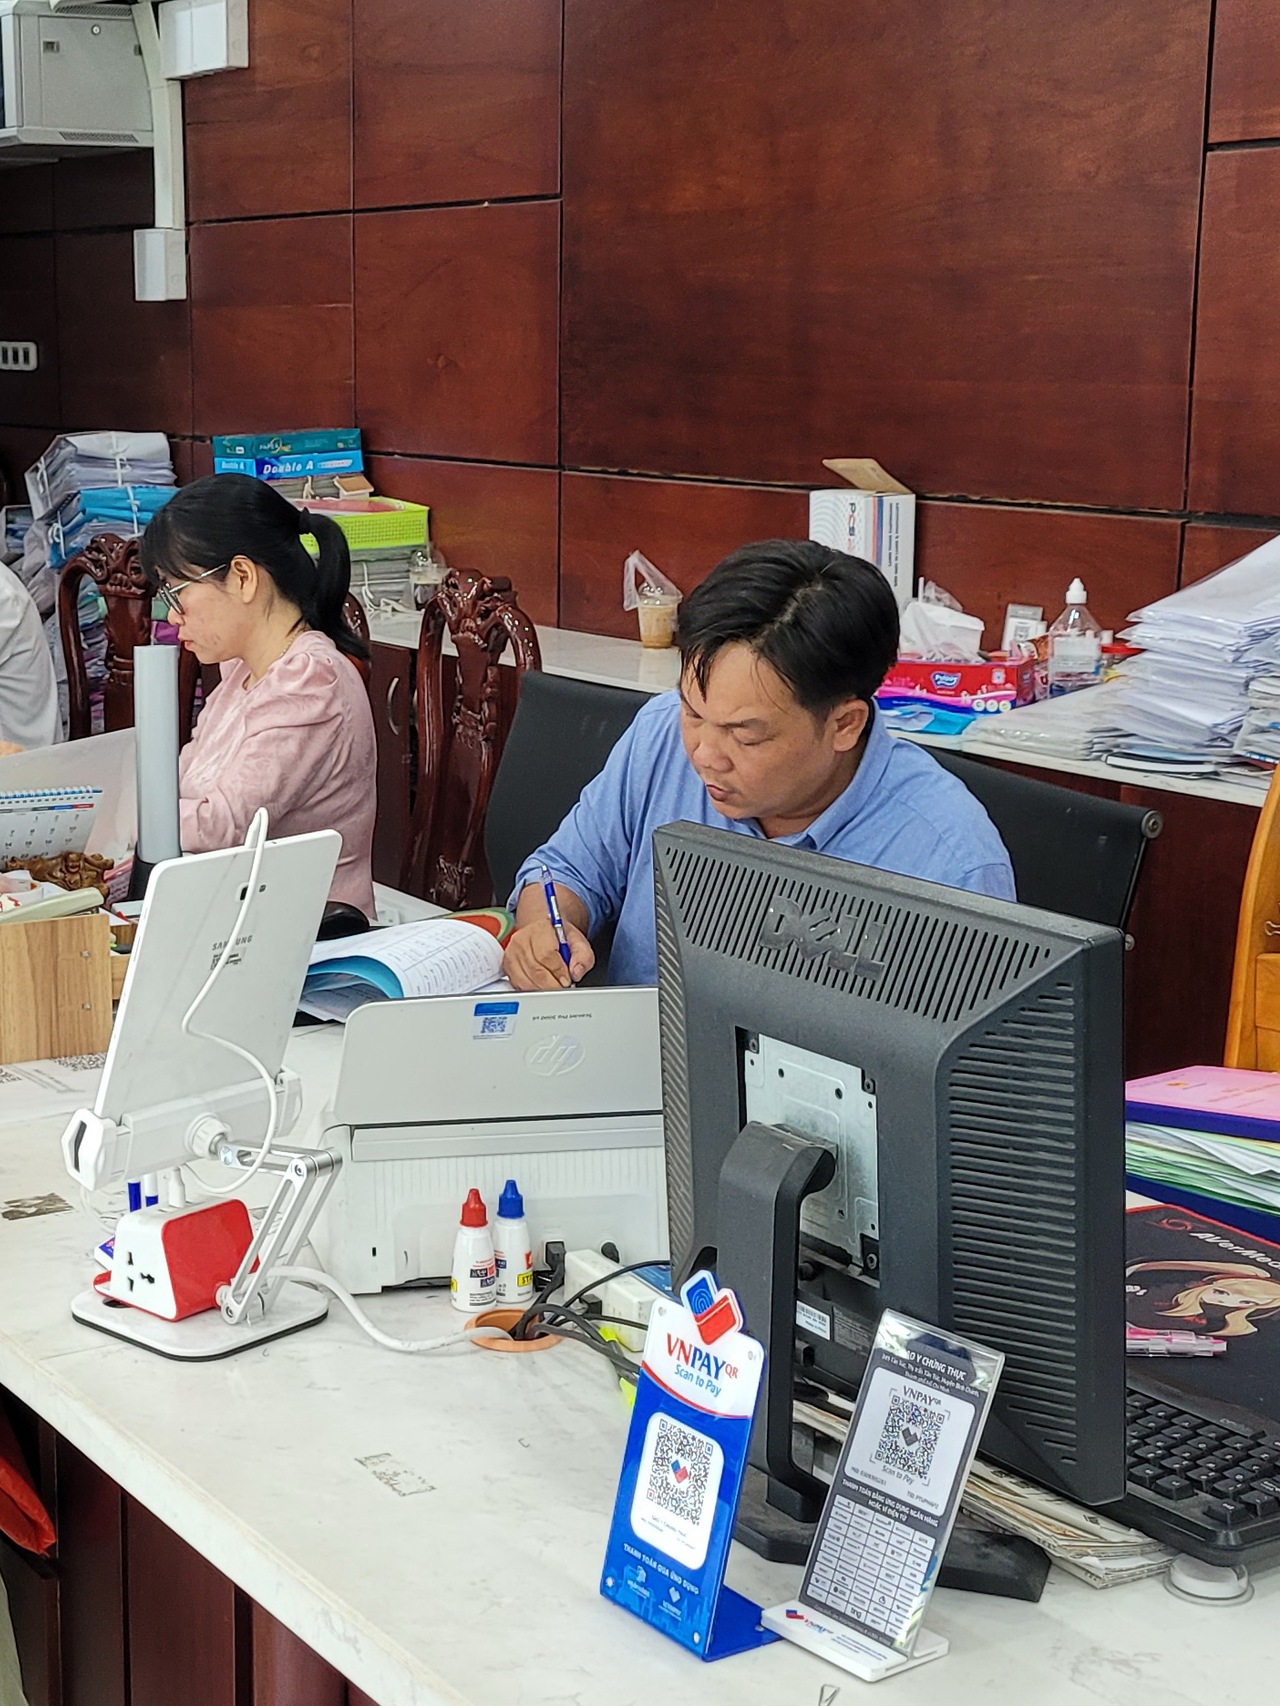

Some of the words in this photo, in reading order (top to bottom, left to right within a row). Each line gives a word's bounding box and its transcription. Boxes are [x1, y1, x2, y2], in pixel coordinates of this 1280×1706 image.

[263, 461, 302, 474] Double
[306, 460, 314, 470] A
[916, 1354, 922, 1364] Y
[674, 1364, 694, 1383] Scan
[695, 1375, 704, 1387] to
[705, 1380, 721, 1398] Pay
[881, 1465, 895, 1476] Scan
[896, 1471, 903, 1479] to
[903, 1473, 915, 1485] Pay
